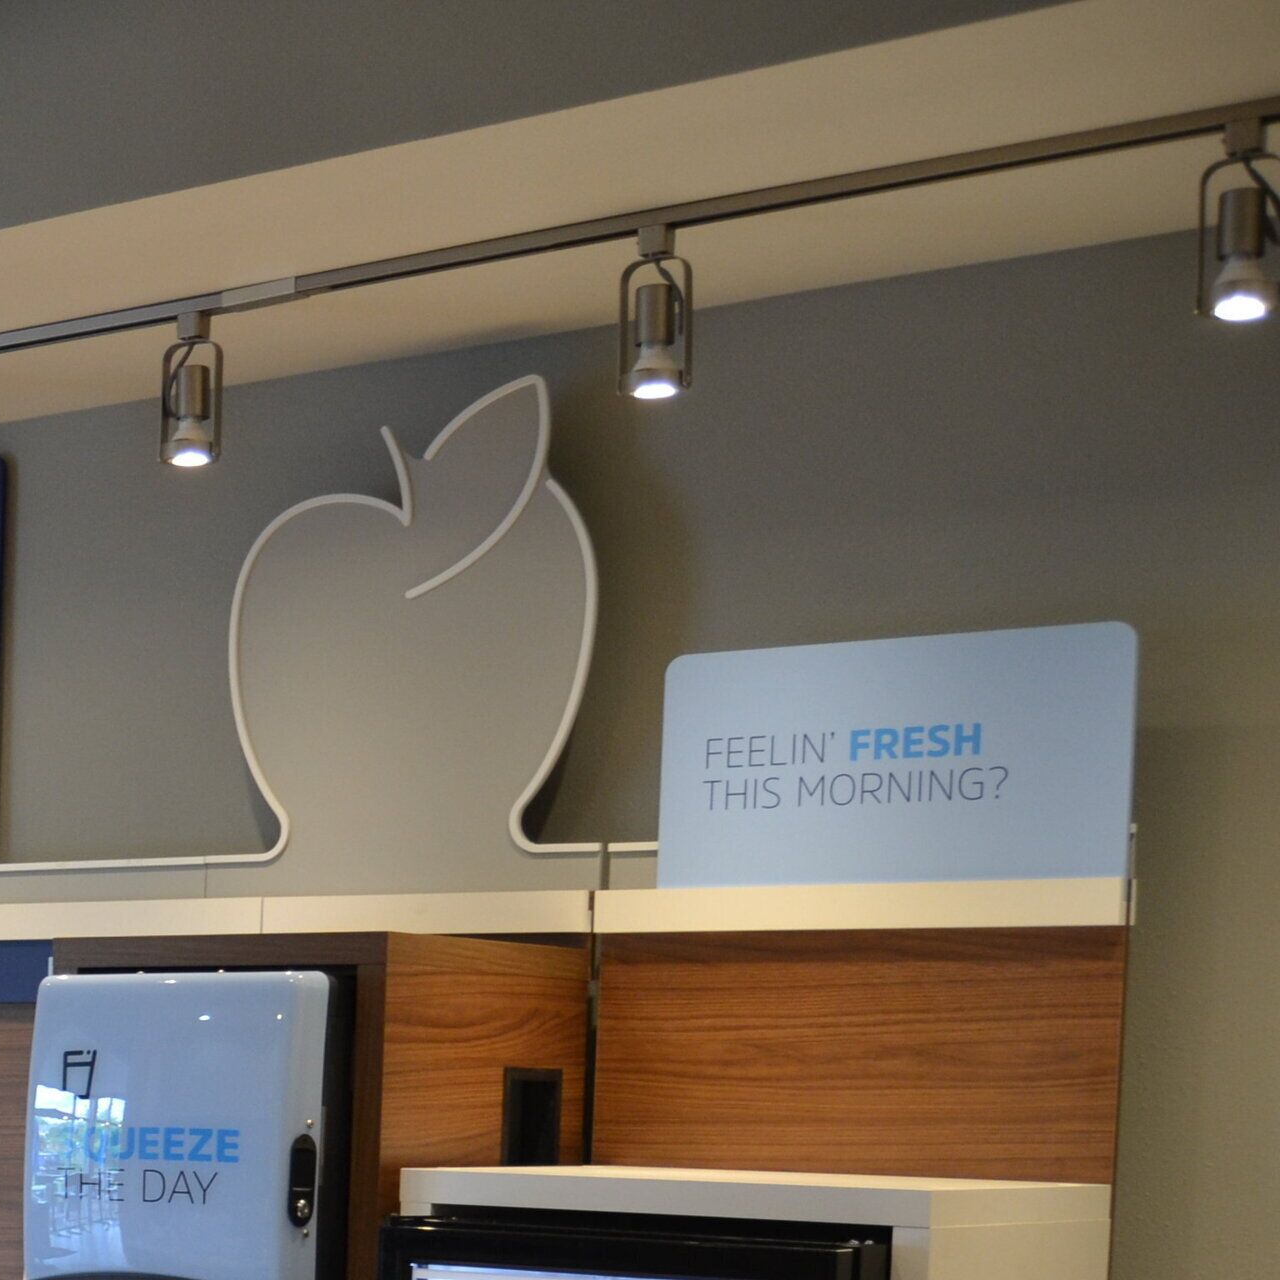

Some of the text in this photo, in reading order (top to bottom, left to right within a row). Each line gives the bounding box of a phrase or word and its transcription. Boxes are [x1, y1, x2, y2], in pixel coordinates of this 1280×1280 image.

[848, 723, 983, 761] FRESH
[703, 766, 1009, 811] THIS MORNING?
[57, 1167, 218, 1205] THE DAY
